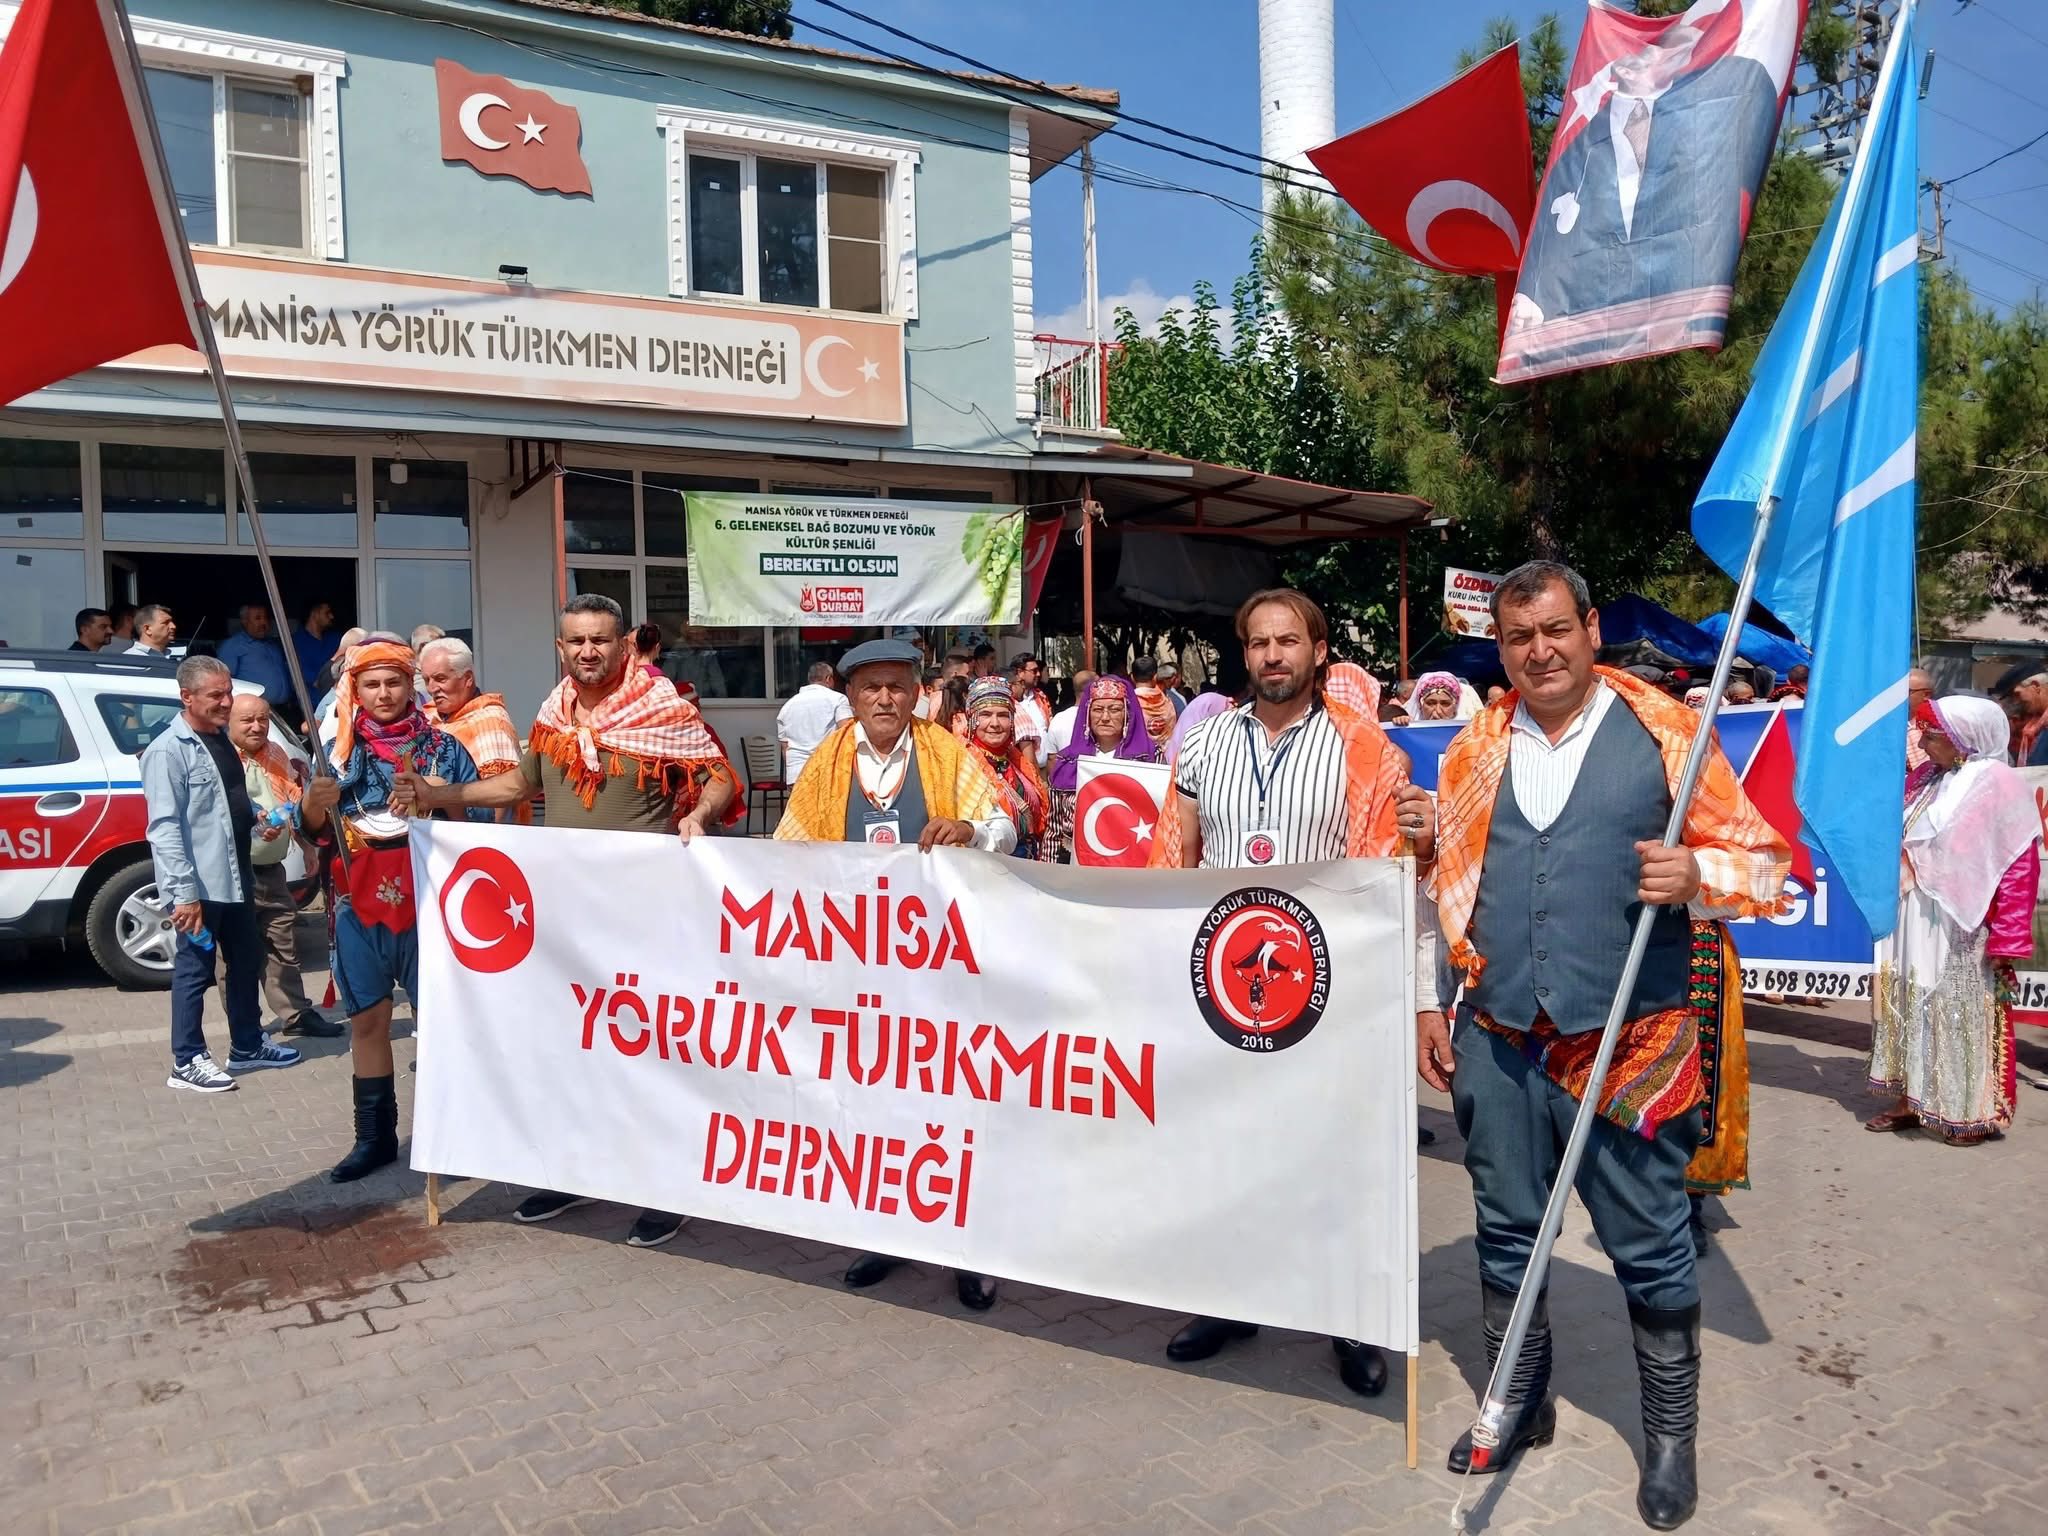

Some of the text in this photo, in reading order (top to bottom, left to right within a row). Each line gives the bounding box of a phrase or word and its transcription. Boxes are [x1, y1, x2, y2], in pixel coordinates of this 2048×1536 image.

[204, 294, 786, 385] MANİSA YÖRÜK TÜRKMEN DERNEĞİ
[745, 505, 909, 520] MANİSA YÖRÜK VE TÜRKMEN DERNEĞİ
[715, 520, 936, 536] 6. GELENEKSEL BAĞ BOZUMU VE YÖRÜK
[786, 537, 875, 550] KÜLTÜR ŞENLİĞİ
[763, 557, 897, 573] BEREKETLİ OLSUN
[820, 602, 861, 612] DURBAY
[0, 828, 51, 859] ASI
[720, 876, 980, 975] MANİSA
[1191, 937, 1210, 999] MANİSA
[1204, 893, 1247, 932] YÖRÜK
[1248, 890, 1316, 932] TÜRKMEN
[1765, 970, 1798, 992] 698
[1805, 972, 1850, 997] 9339
[570, 973, 1155, 1127] YÖRÜK TÜRKMEN
[1241, 1034, 1273, 1049] 2016
[702, 1112, 974, 1229] DERNEĞİ
